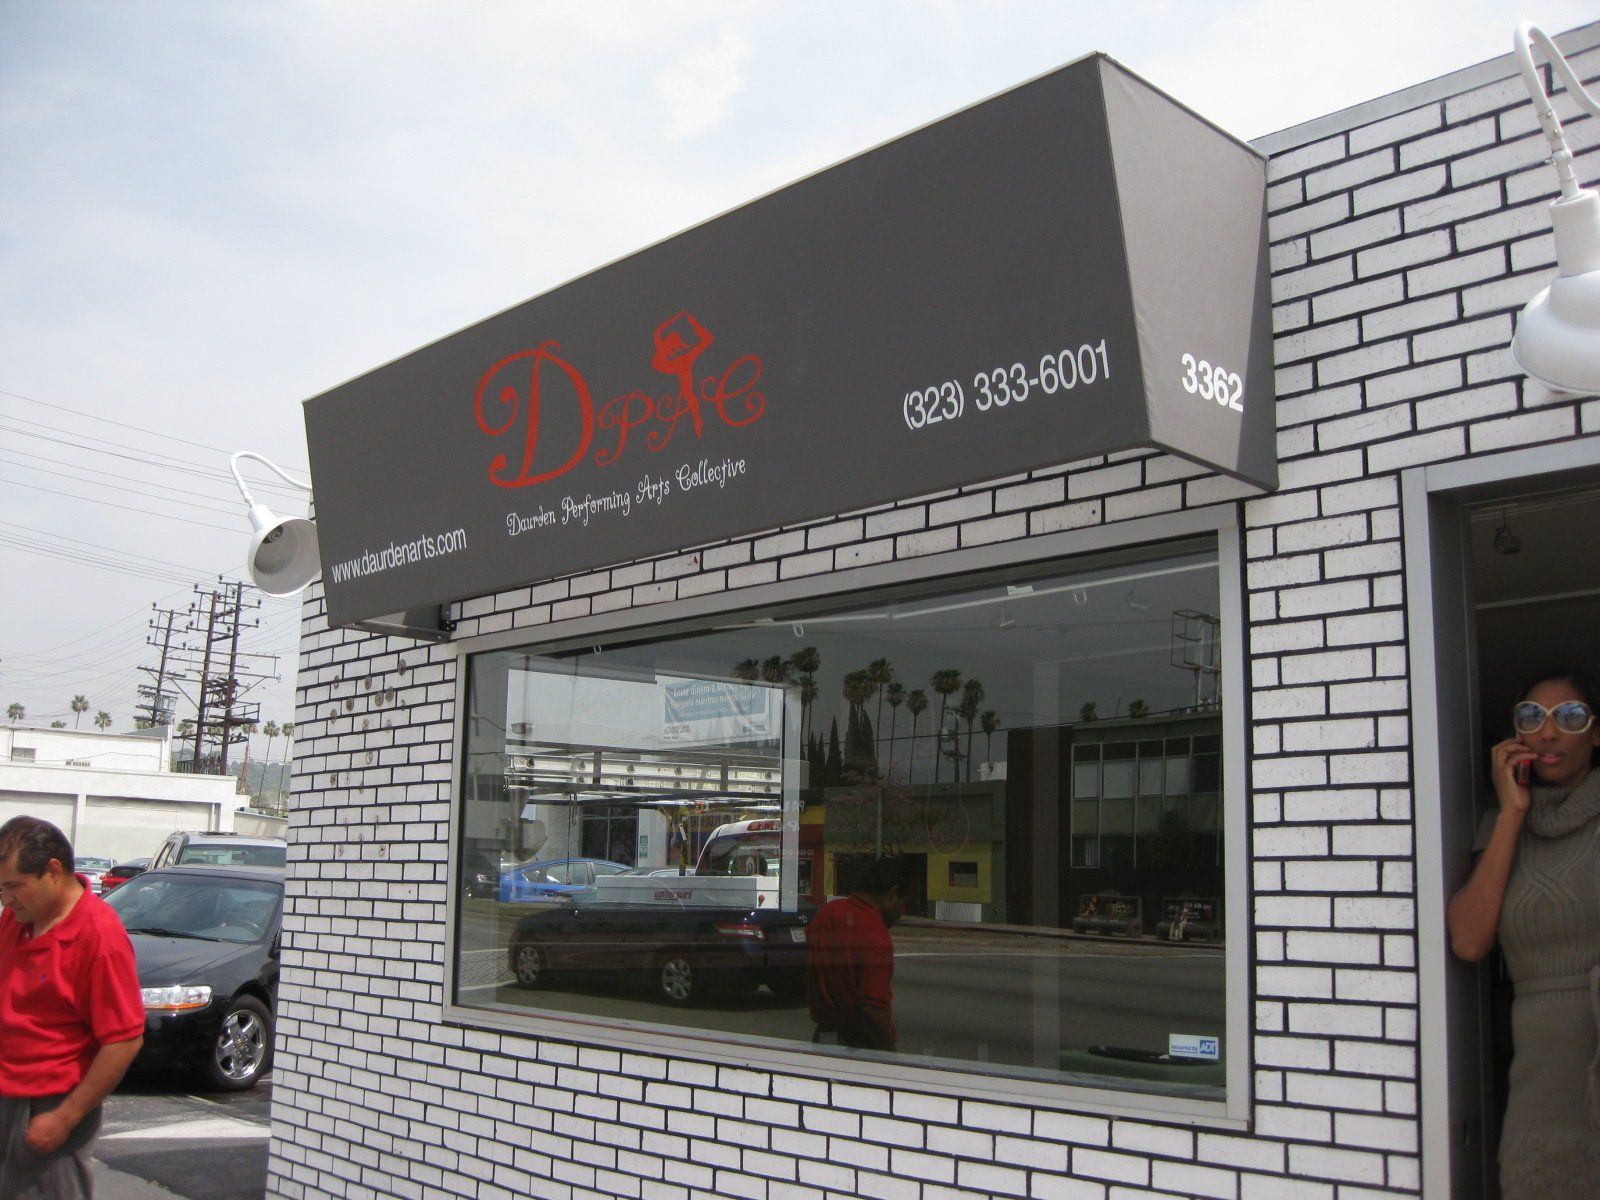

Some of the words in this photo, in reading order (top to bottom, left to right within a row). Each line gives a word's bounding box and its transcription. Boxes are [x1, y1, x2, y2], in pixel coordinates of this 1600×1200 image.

[903, 380, 965, 430] (323)
[973, 339, 1110, 411] 333-6001
[1181, 353, 1244, 412] 3362
[506, 505, 556, 536] Daurden
[562, 494, 631, 526] Performing
[636, 474, 670, 505] Arts
[675, 458, 746, 491] Collective
[332, 528, 467, 583] www.daurdenarts.com
[1200, 1041, 1216, 1054] ADT
